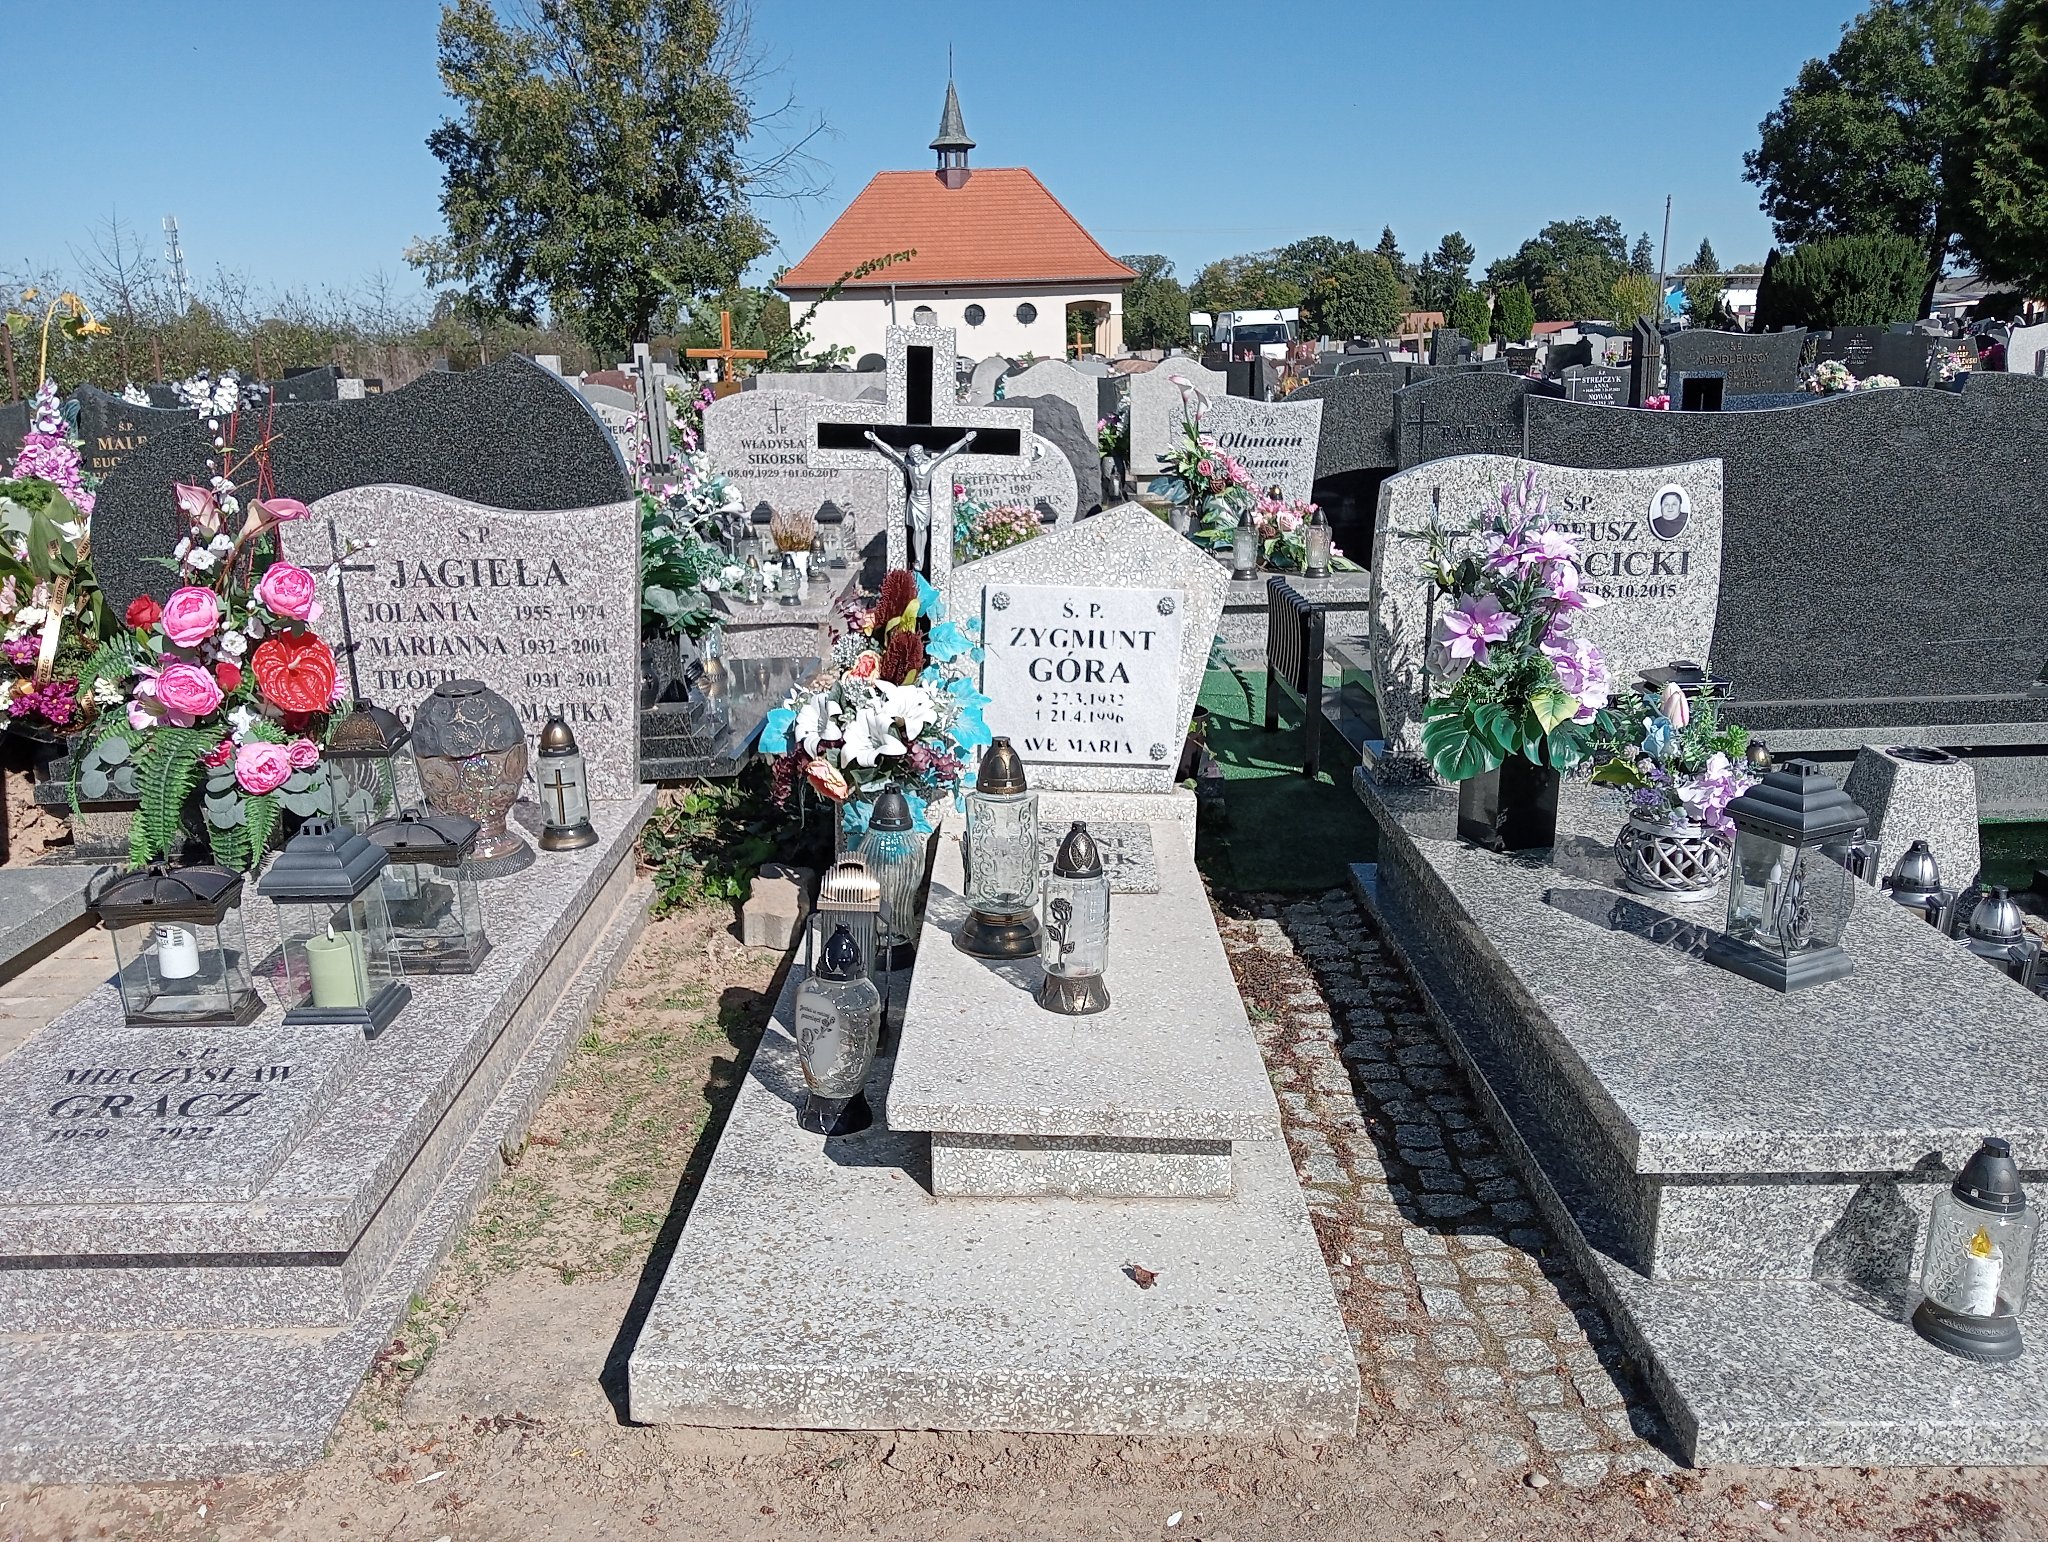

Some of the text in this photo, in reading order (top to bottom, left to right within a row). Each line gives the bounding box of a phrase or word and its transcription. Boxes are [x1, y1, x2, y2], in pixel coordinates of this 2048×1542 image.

[1219, 432, 1303, 449] Oltmann
[747, 453, 807, 465] SIKORSK
[1010, 484, 1032, 495] 1989
[1548, 521, 1639, 542] DEUSZ
[391, 558, 570, 590] JAGIEŁA
[364, 601, 481, 624] JOLANTA
[515, 602, 552, 621] 1955
[568, 602, 607, 621] 1974
[1089, 603, 1104, 619] P.
[368, 637, 508, 657] MARIANNA
[519, 638, 556, 656] 1932
[571, 638, 608, 655] 2001
[1009, 626, 1157, 651] ZYGMUNT
[1028, 651, 1130, 684] GÓRA
[525, 671, 560, 689] 1931
[577, 671, 613, 689] 2011
[1024, 737, 1134, 754] AVE MARIA
[48, 1092, 262, 1119] GRACZ
